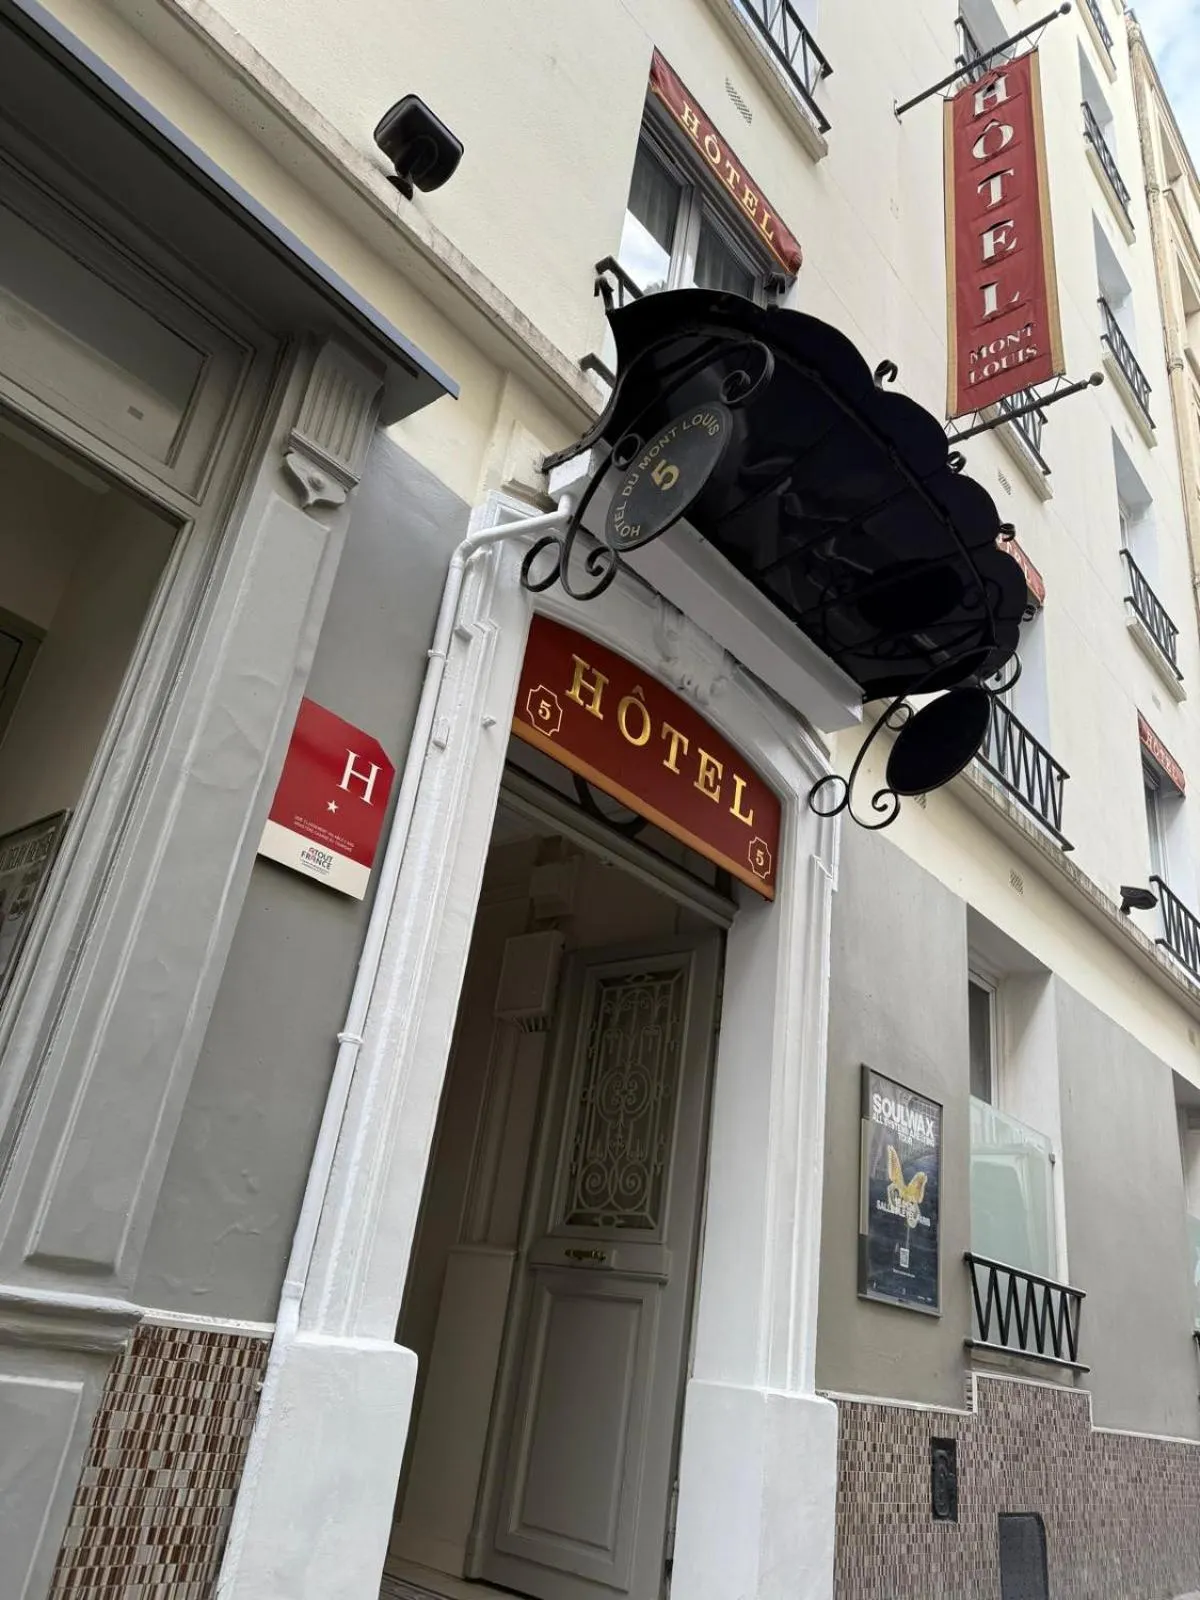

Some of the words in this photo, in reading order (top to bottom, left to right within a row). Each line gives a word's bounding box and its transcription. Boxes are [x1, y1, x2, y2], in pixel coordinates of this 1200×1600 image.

[680, 101, 776, 241] HÔTEL
[972, 73, 1020, 319] HÔTEL
[969, 322, 1037, 365] MONT
[968, 344, 1037, 384] LOUIS
[683, 413, 720, 437] LOUIS
[638, 427, 678, 470] MONT
[622, 473, 640, 497] DU
[651, 459, 680, 491] 5
[614, 500, 641, 537] HOTEL
[538, 700, 552, 721] 5
[565, 653, 755, 827] HÔTEL
[336, 749, 383, 806] H
[300, 850, 333, 870] FRANCE
[756, 850, 765, 867] 5
[872, 1092, 935, 1141] SOULWAX
